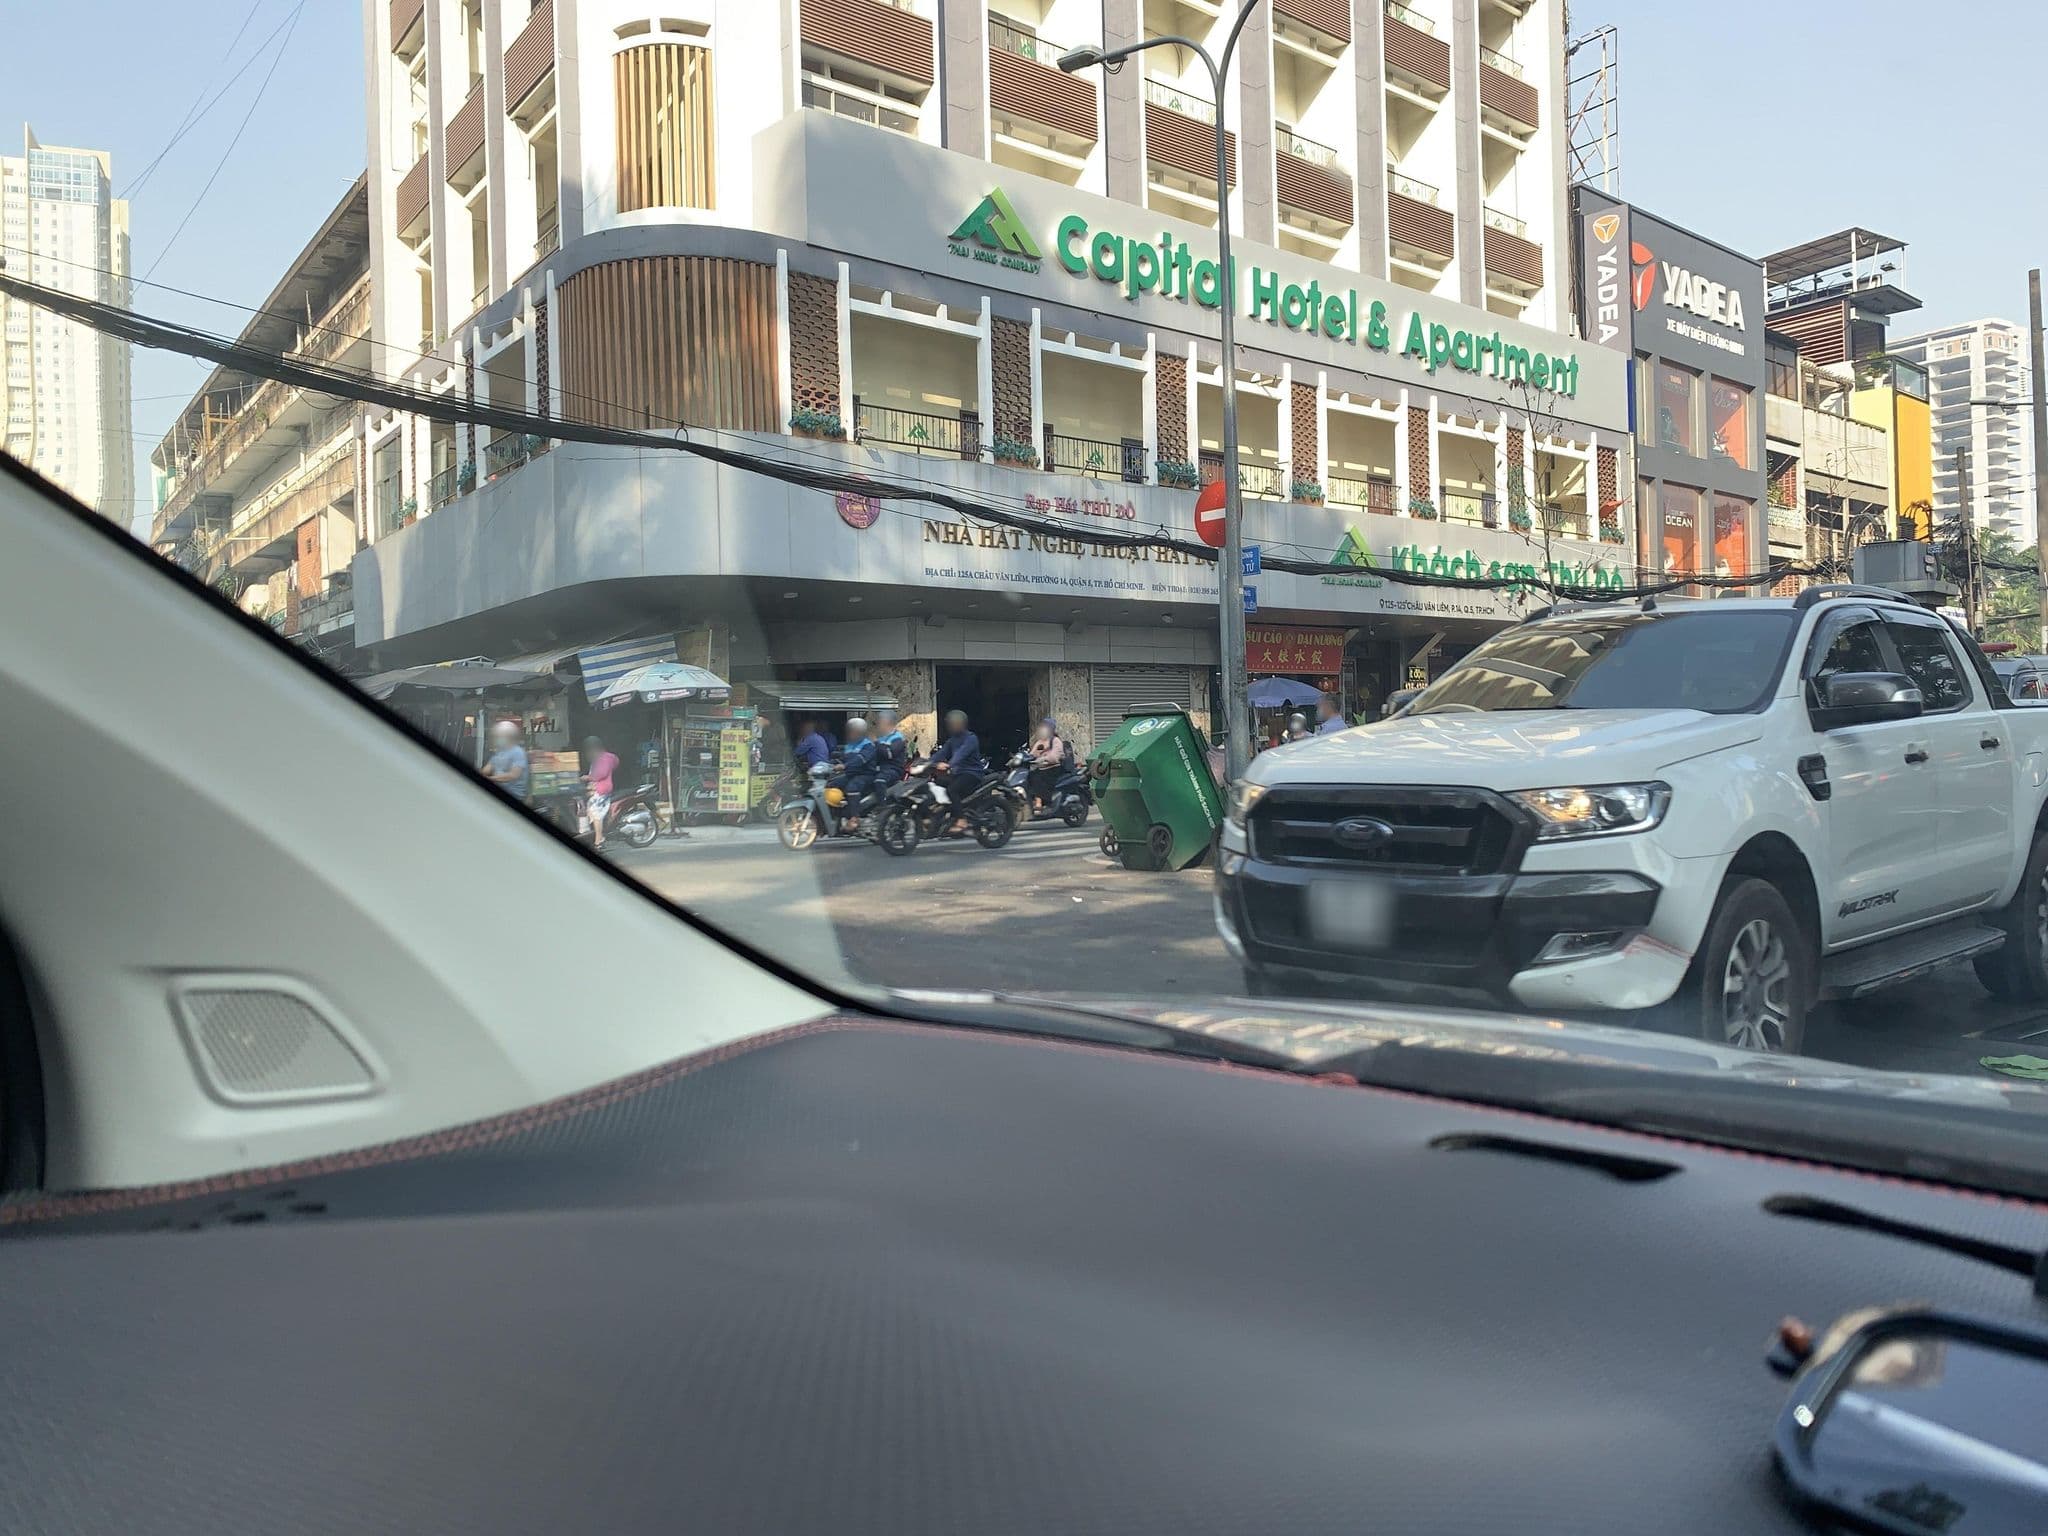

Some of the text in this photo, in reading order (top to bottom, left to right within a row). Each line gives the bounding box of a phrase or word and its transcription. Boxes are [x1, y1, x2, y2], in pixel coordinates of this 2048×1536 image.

[1057, 215, 1579, 396] Capital Hotel & Apartment
[1597, 245, 1619, 344] YADEA
[1661, 261, 1746, 331] YADEA
[923, 517, 974, 546] NHÀ
[1665, 515, 1693, 528] OCEAN
[925, 567, 939, 578] ĐỊA
[957, 569, 974, 579] 125A
[974, 569, 994, 580] CHÂU
[994, 571, 1010, 581] VĂN
[1069, 578, 1087, 588] QUẬN
[1391, 544, 1481, 581] Khách
[1407, 600, 1423, 611] CHÂU
[1424, 601, 1436, 611] VĂN
[1476, 606, 1496, 615] TP.HCM
